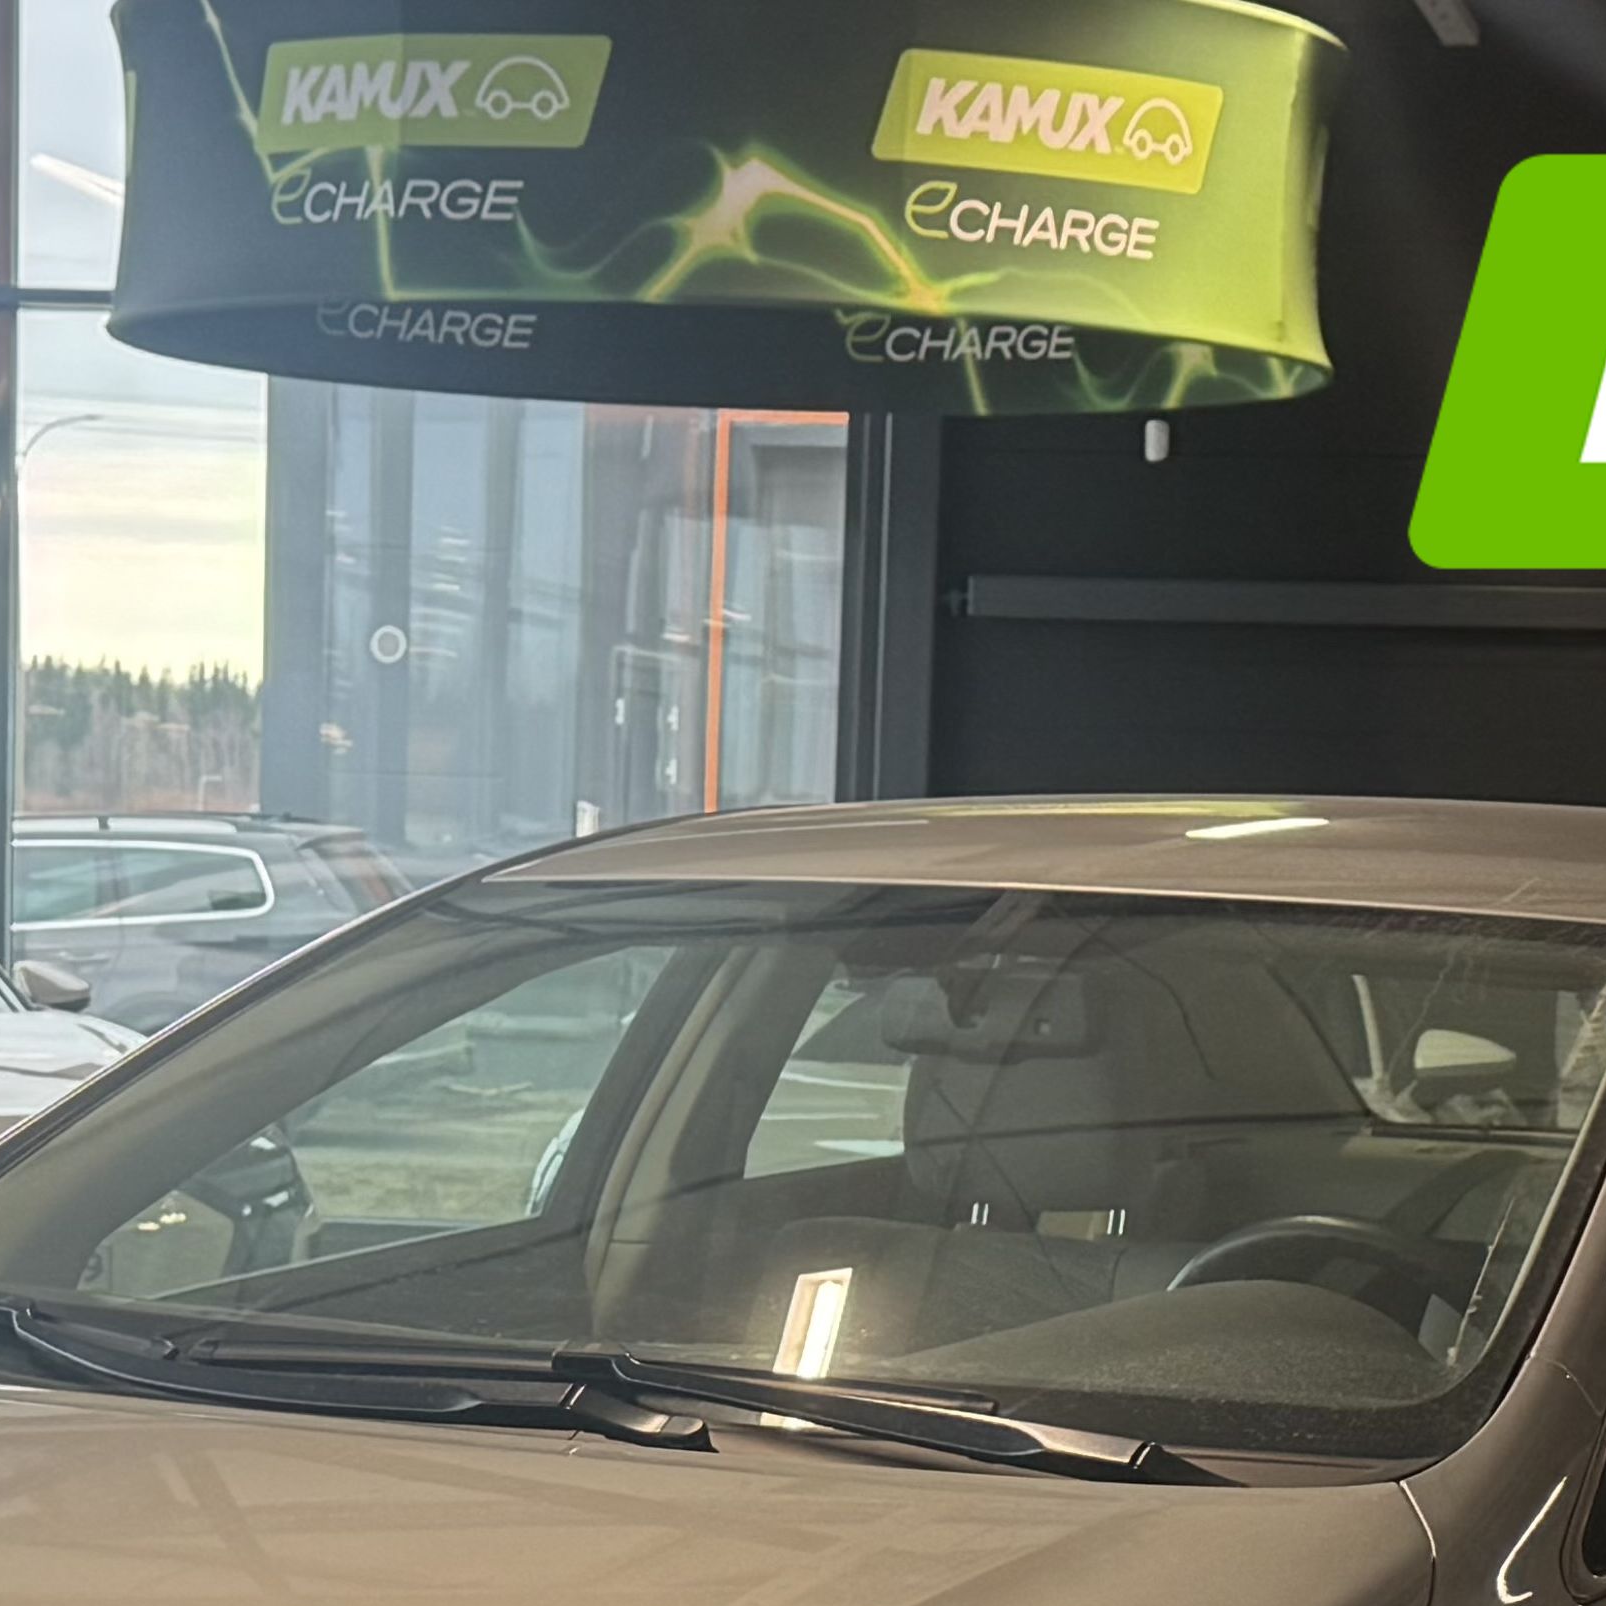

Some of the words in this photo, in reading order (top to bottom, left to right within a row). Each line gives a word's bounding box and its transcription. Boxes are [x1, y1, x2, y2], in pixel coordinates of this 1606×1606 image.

[280, 60, 472, 125] KAMUX
[915, 76, 1126, 154] KAMUX
[903, 180, 1161, 259] eCHARGE
